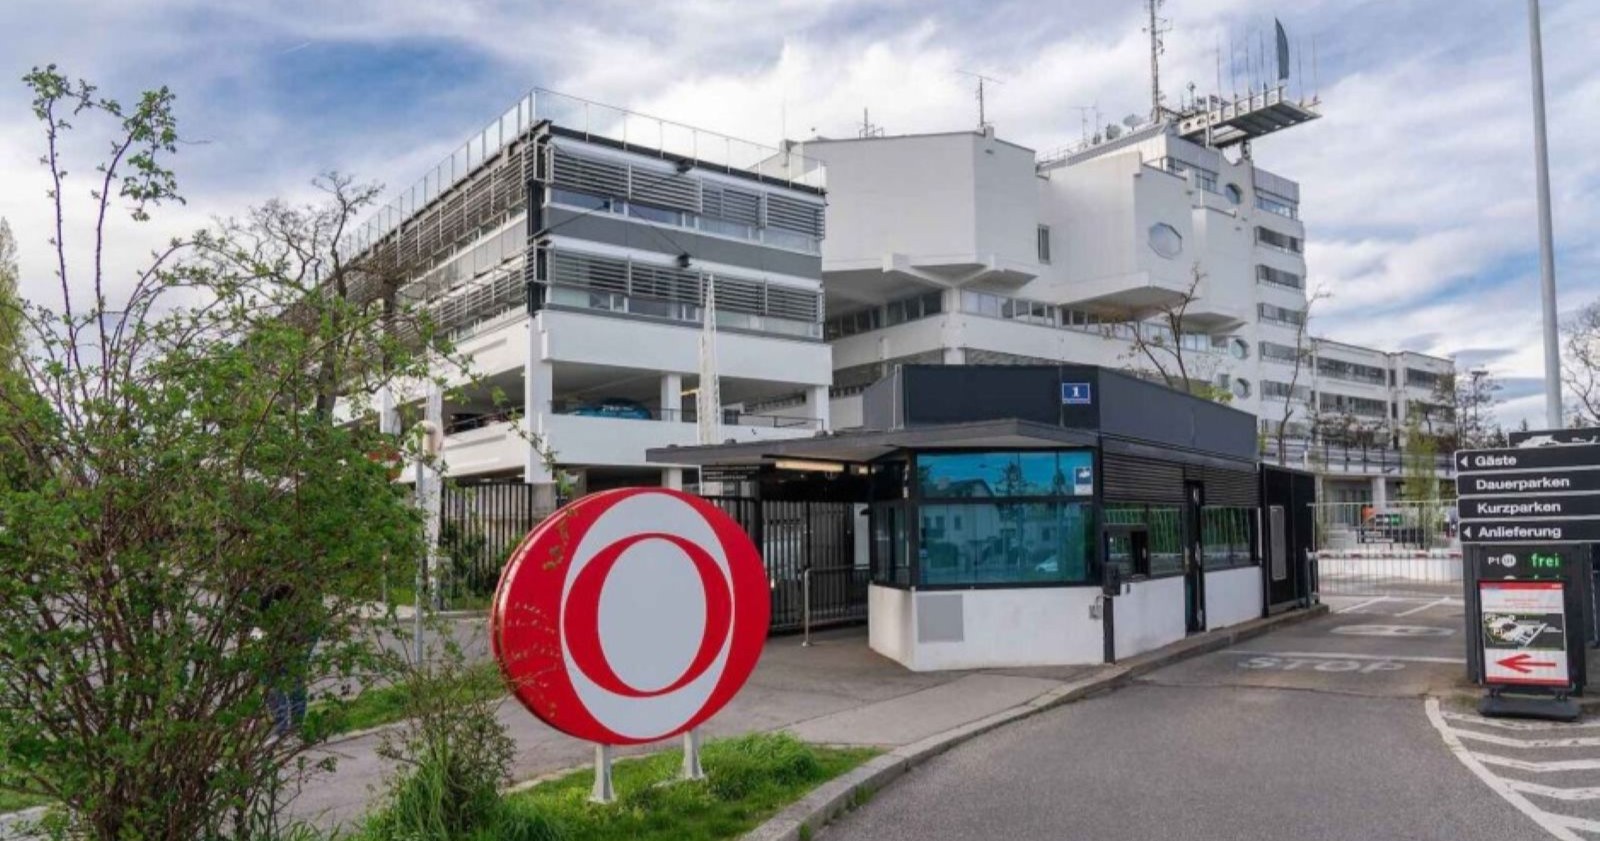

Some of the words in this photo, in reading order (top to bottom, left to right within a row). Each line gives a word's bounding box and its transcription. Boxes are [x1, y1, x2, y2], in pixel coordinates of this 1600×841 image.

[1072, 386, 1079, 397] 1
[1475, 456, 1517, 467] Gäste
[1476, 477, 1570, 491] Dauerparken
[1477, 502, 1561, 514] Kurzparken
[1478, 526, 1562, 538] Anlieferung
[1531, 552, 1560, 568] frei
[1238, 656, 1406, 673] STOP
